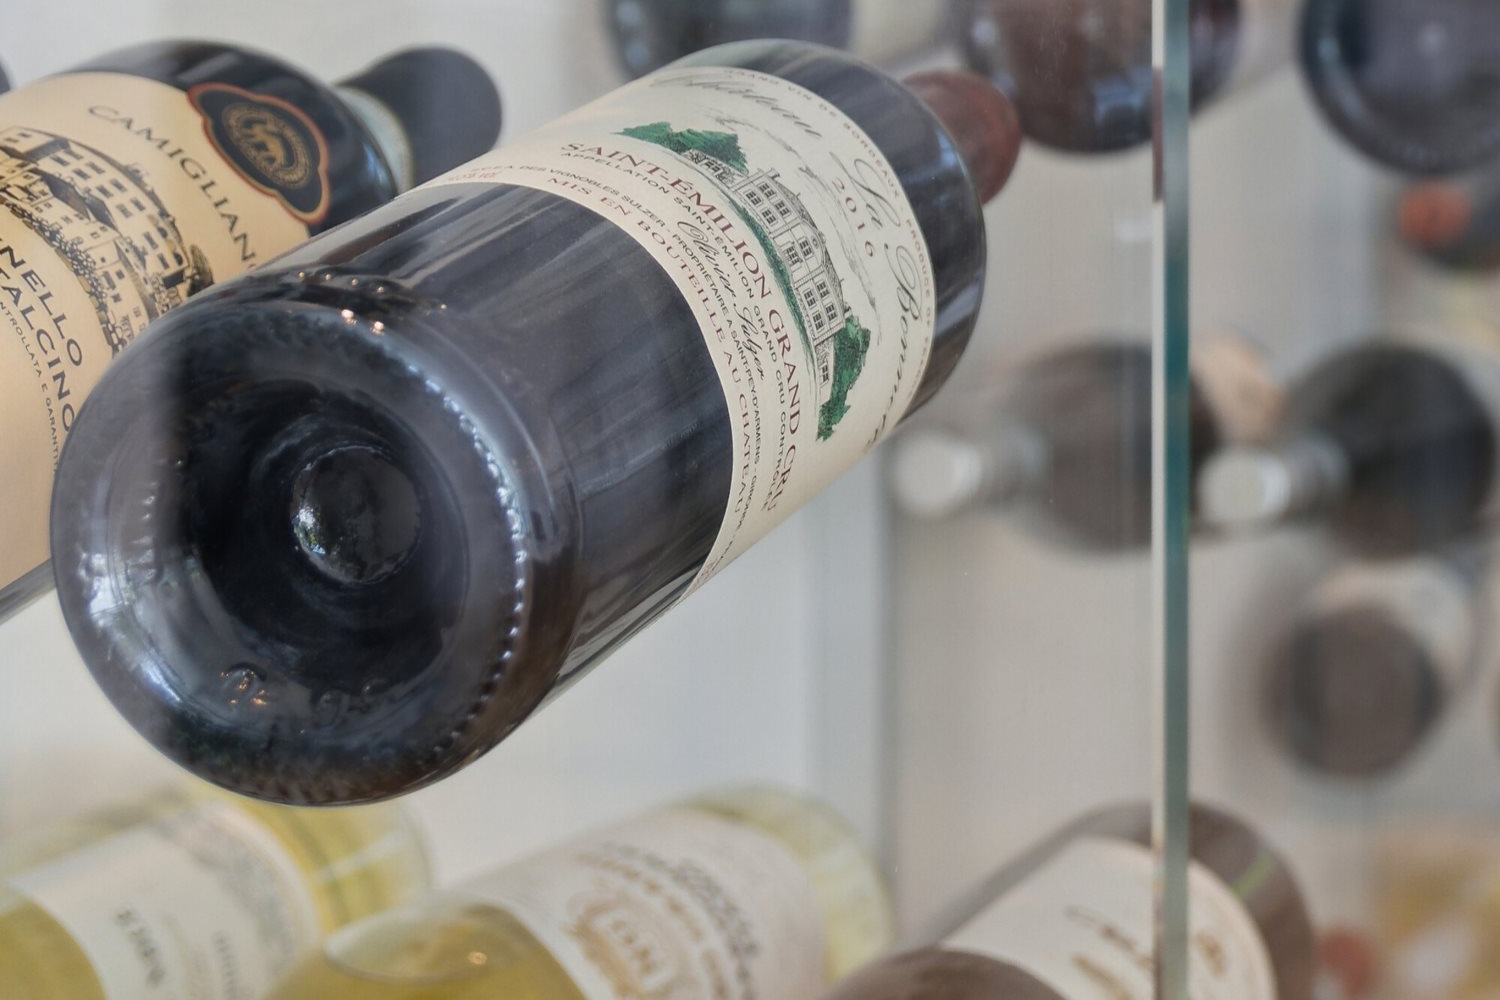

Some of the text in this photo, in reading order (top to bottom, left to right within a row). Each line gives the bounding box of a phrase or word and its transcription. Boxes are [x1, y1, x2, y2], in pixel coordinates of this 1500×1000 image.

[88, 104, 257, 269] CAMIGLIAN
[550, 168, 620, 196] VIGNOBLES
[621, 195, 666, 228] SULZER
[831, 176, 875, 258] 2016
[842, 121, 901, 199] BORDEAUX
[904, 217, 932, 298] PRODUCE
[0, 237, 83, 367] NELLO
[547, 178, 593, 195] MIS
[600, 196, 631, 216] EN
[637, 220, 727, 343] BOUTEILLE
[723, 350, 742, 384] AU
[560, 152, 670, 194] APPELLATION
[753, 304, 777, 363] GRAND
[775, 369, 785, 405] CRU
[41, 383, 48, 393] E
[768, 308, 799, 435] GRAND
[767, 444, 796, 512] CRU
